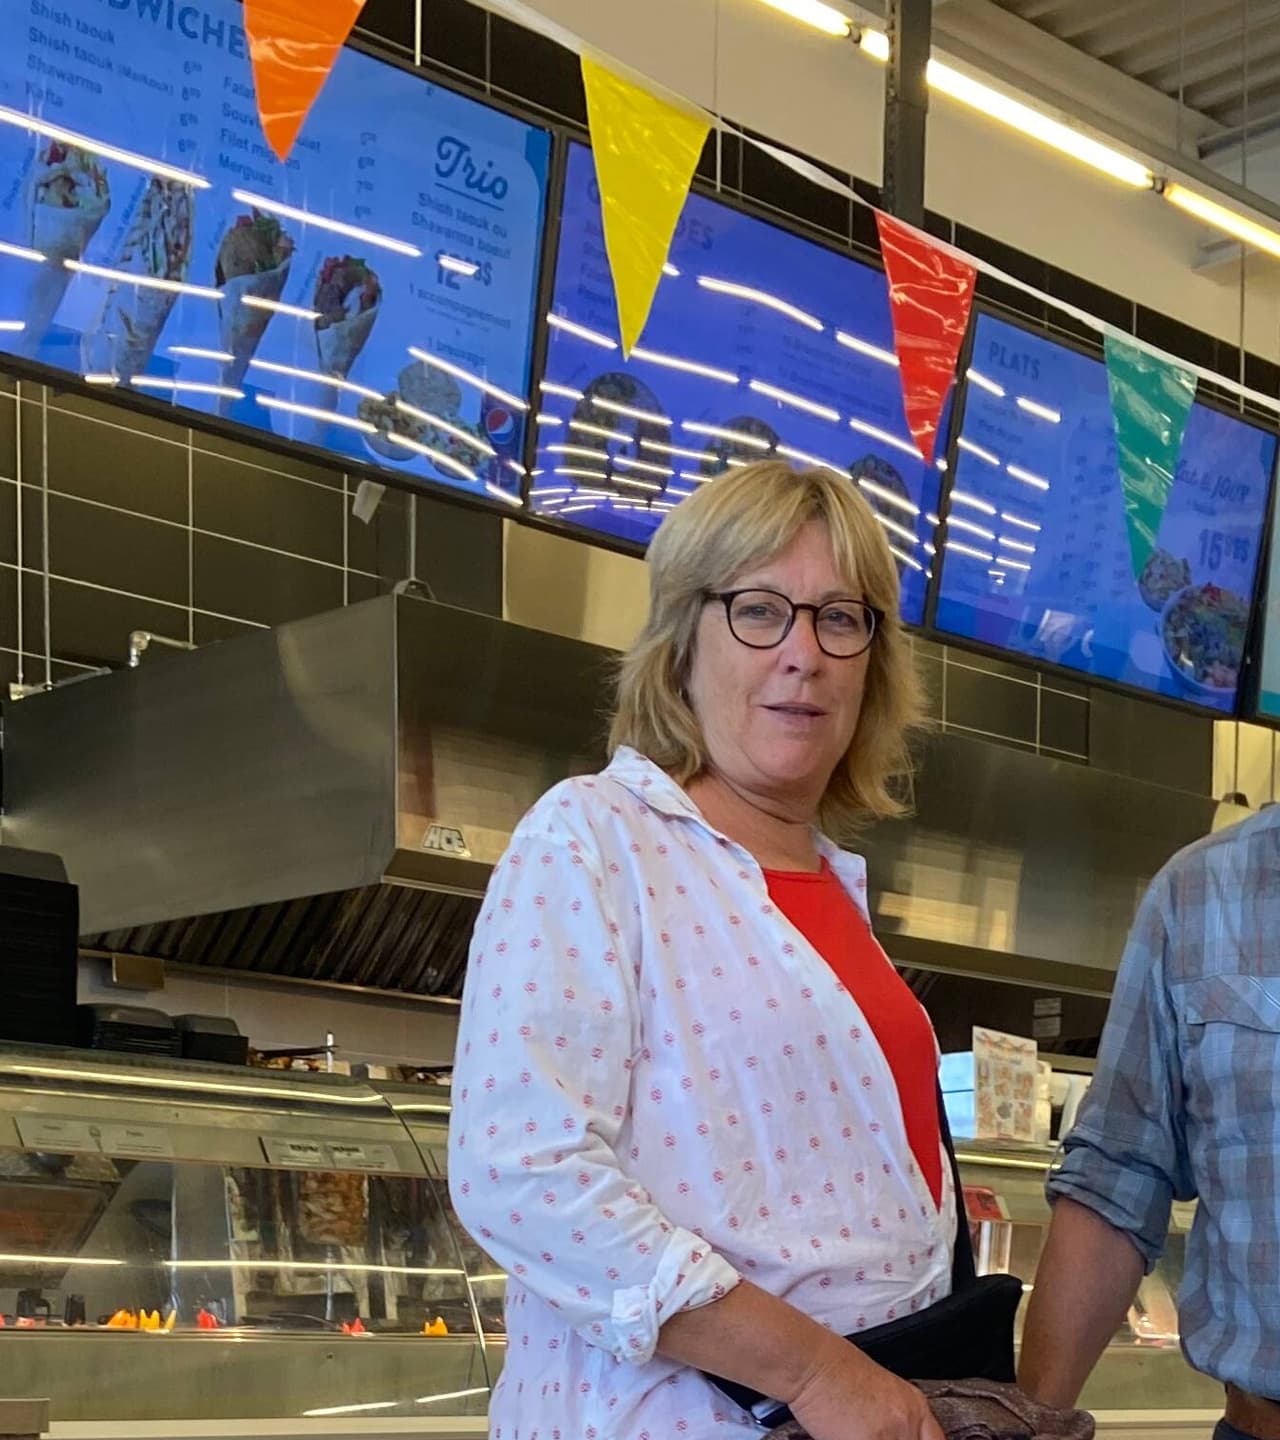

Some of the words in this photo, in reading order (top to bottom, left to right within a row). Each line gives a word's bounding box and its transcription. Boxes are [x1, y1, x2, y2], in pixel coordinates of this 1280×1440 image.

[28, 26, 70, 55] Shish
[26, 54, 104, 95] Shawarma
[218, 152, 274, 187] Merguez
[435, 135, 509, 200] Trio
[988, 340, 1041, 381] PLATS
